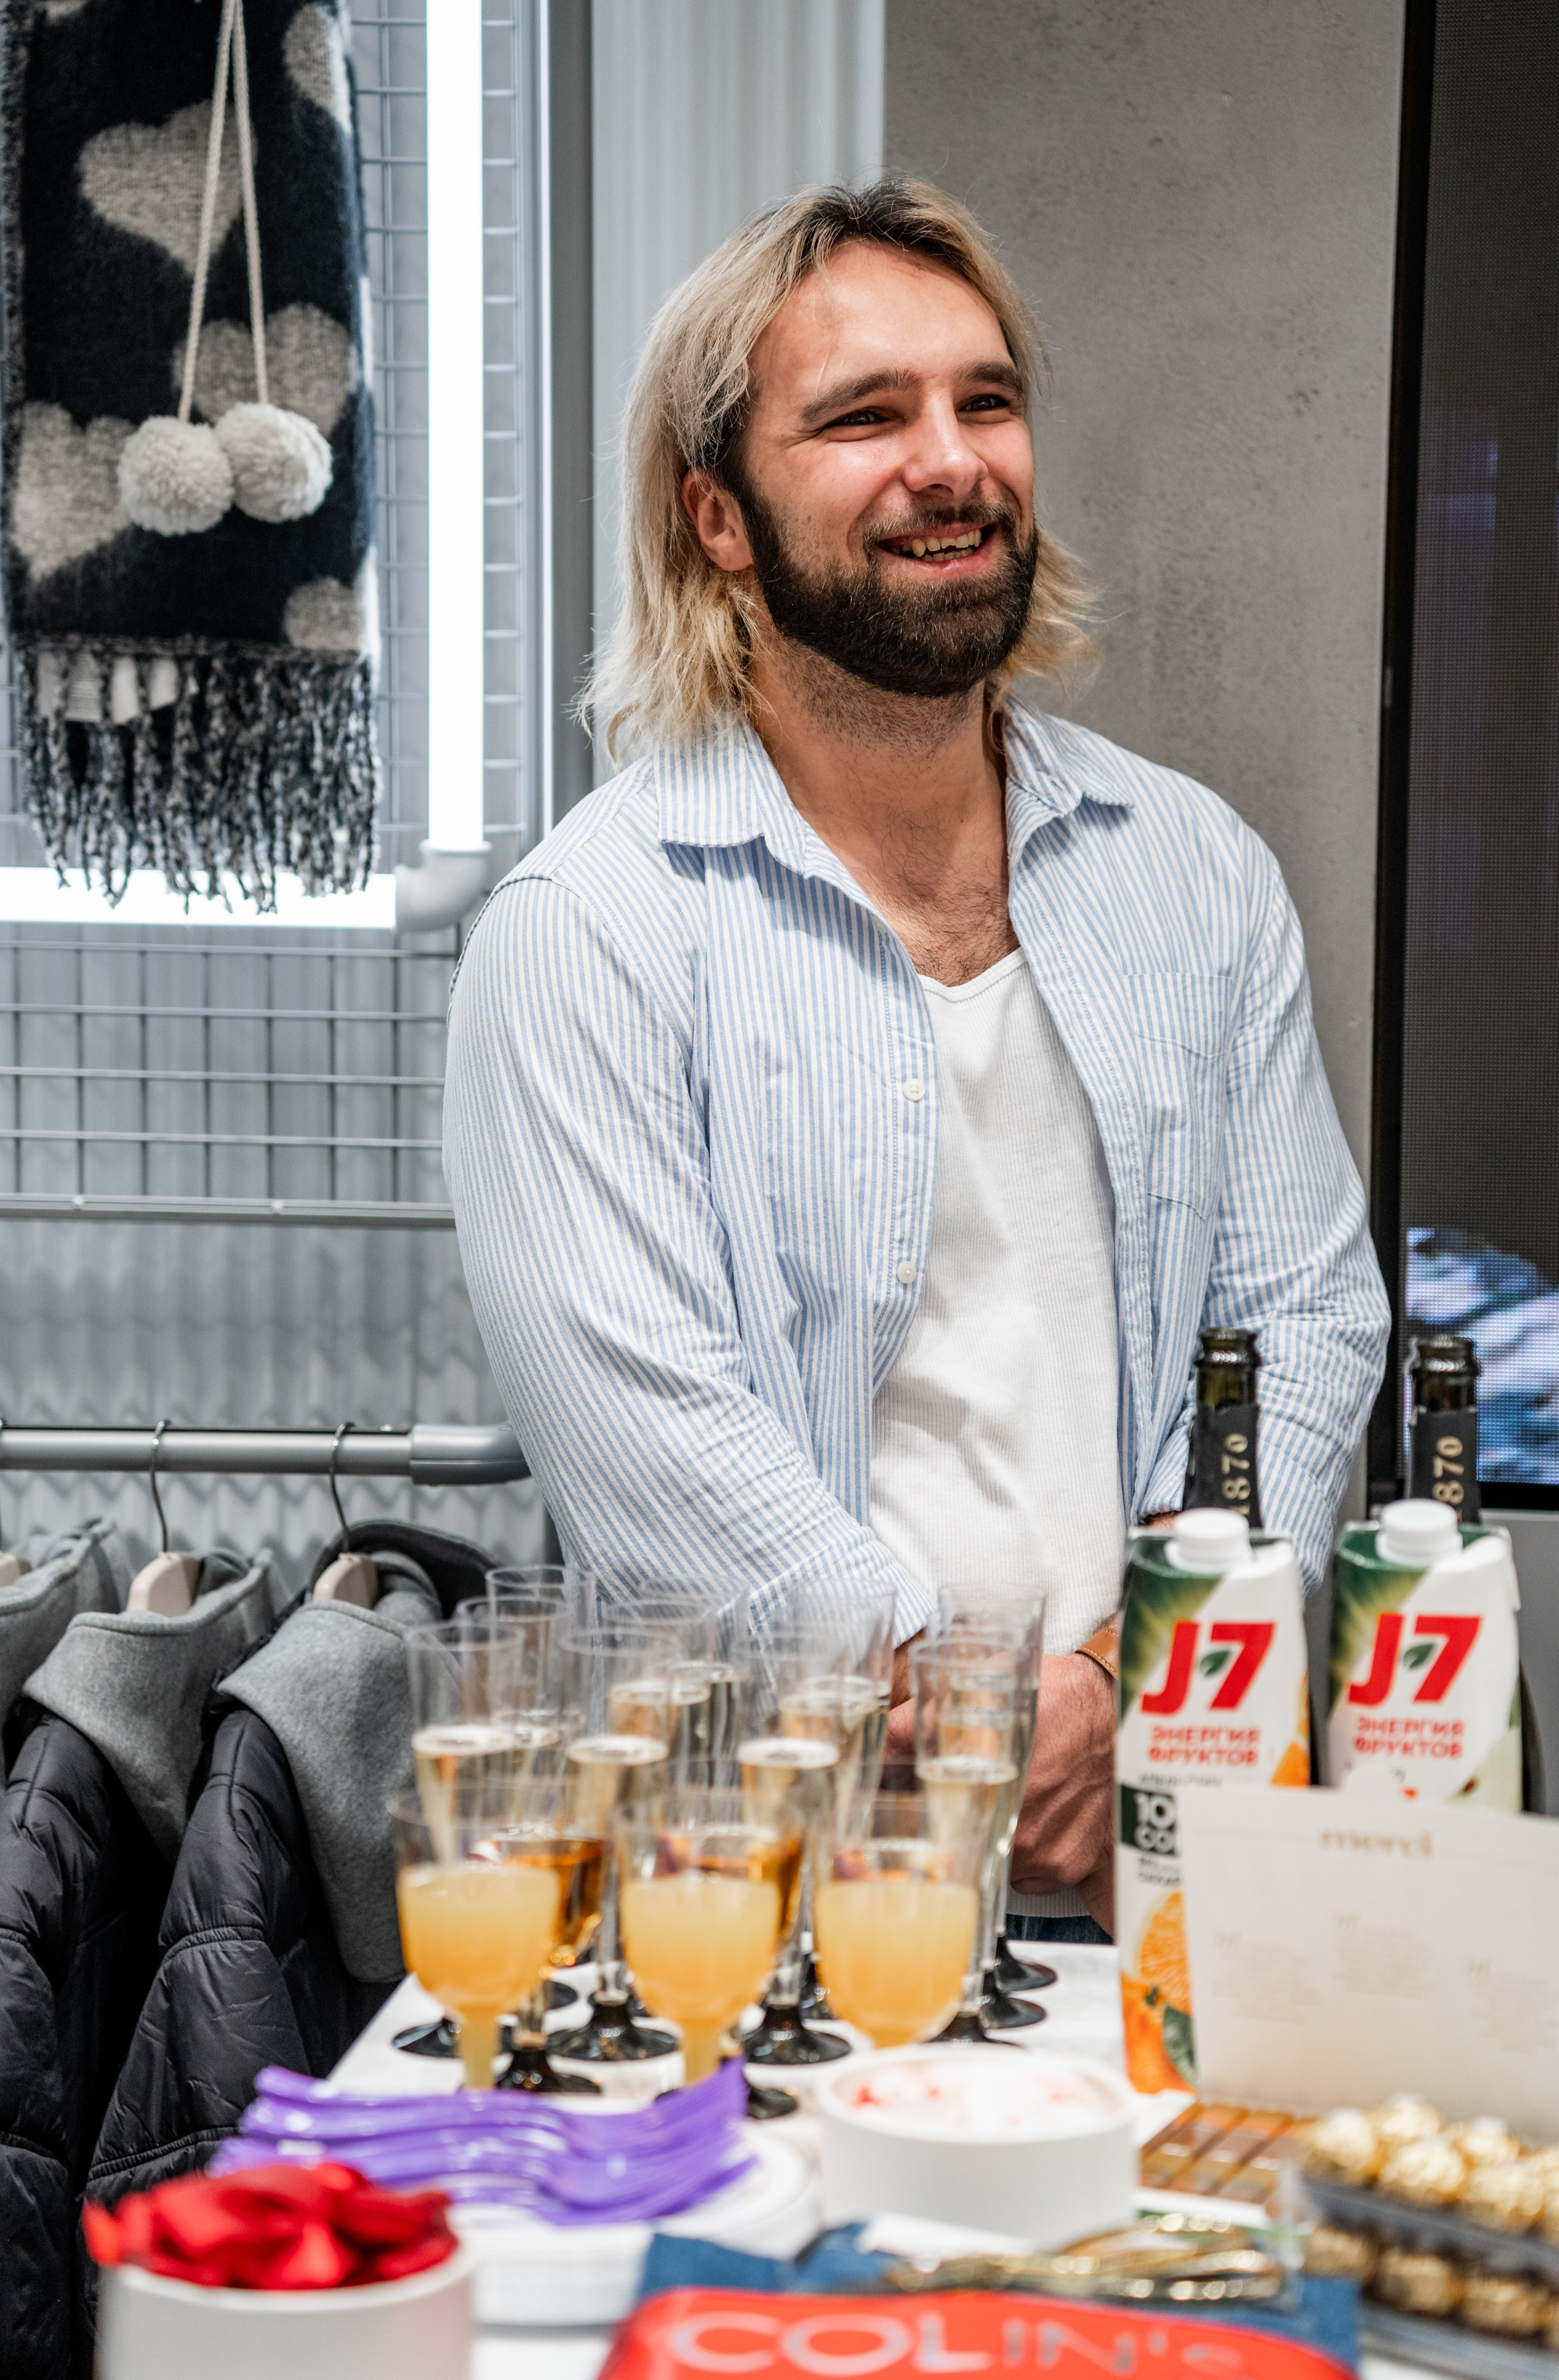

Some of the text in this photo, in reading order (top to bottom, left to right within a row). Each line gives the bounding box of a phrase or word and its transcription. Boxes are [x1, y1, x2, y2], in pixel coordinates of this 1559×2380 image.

[1432, 1435, 1465, 1520] 870
[1140, 1620, 1275, 1715] J7
[1346, 1612, 1481, 1706] J7
